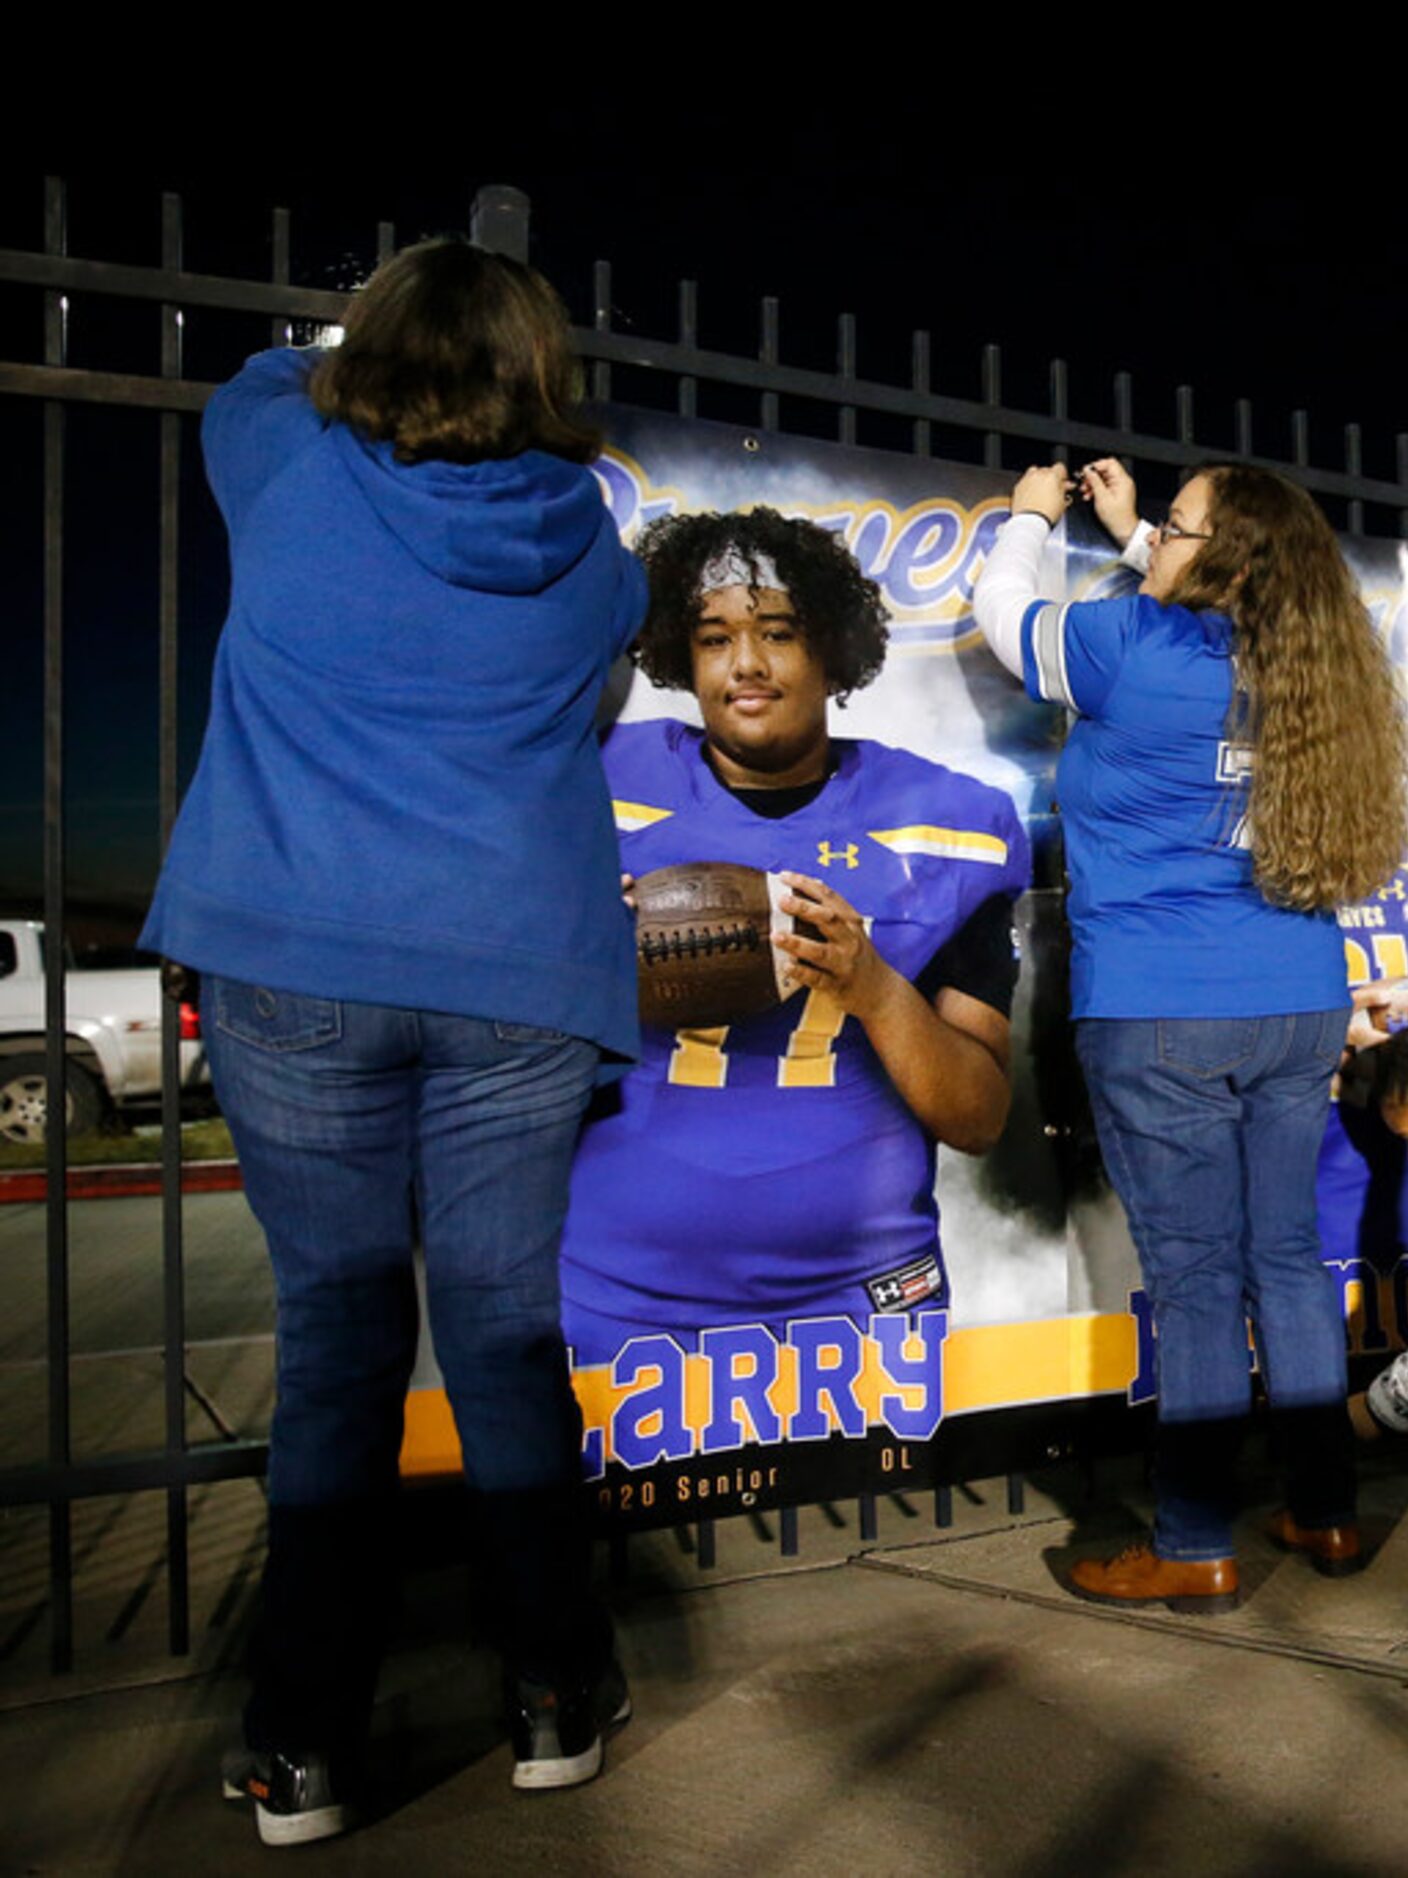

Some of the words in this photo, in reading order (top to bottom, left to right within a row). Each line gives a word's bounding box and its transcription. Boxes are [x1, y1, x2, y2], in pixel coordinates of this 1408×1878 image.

[598, 1478, 657, 1513] 020
[676, 1466, 780, 1502] Senior
[880, 1445, 912, 1473] OL
